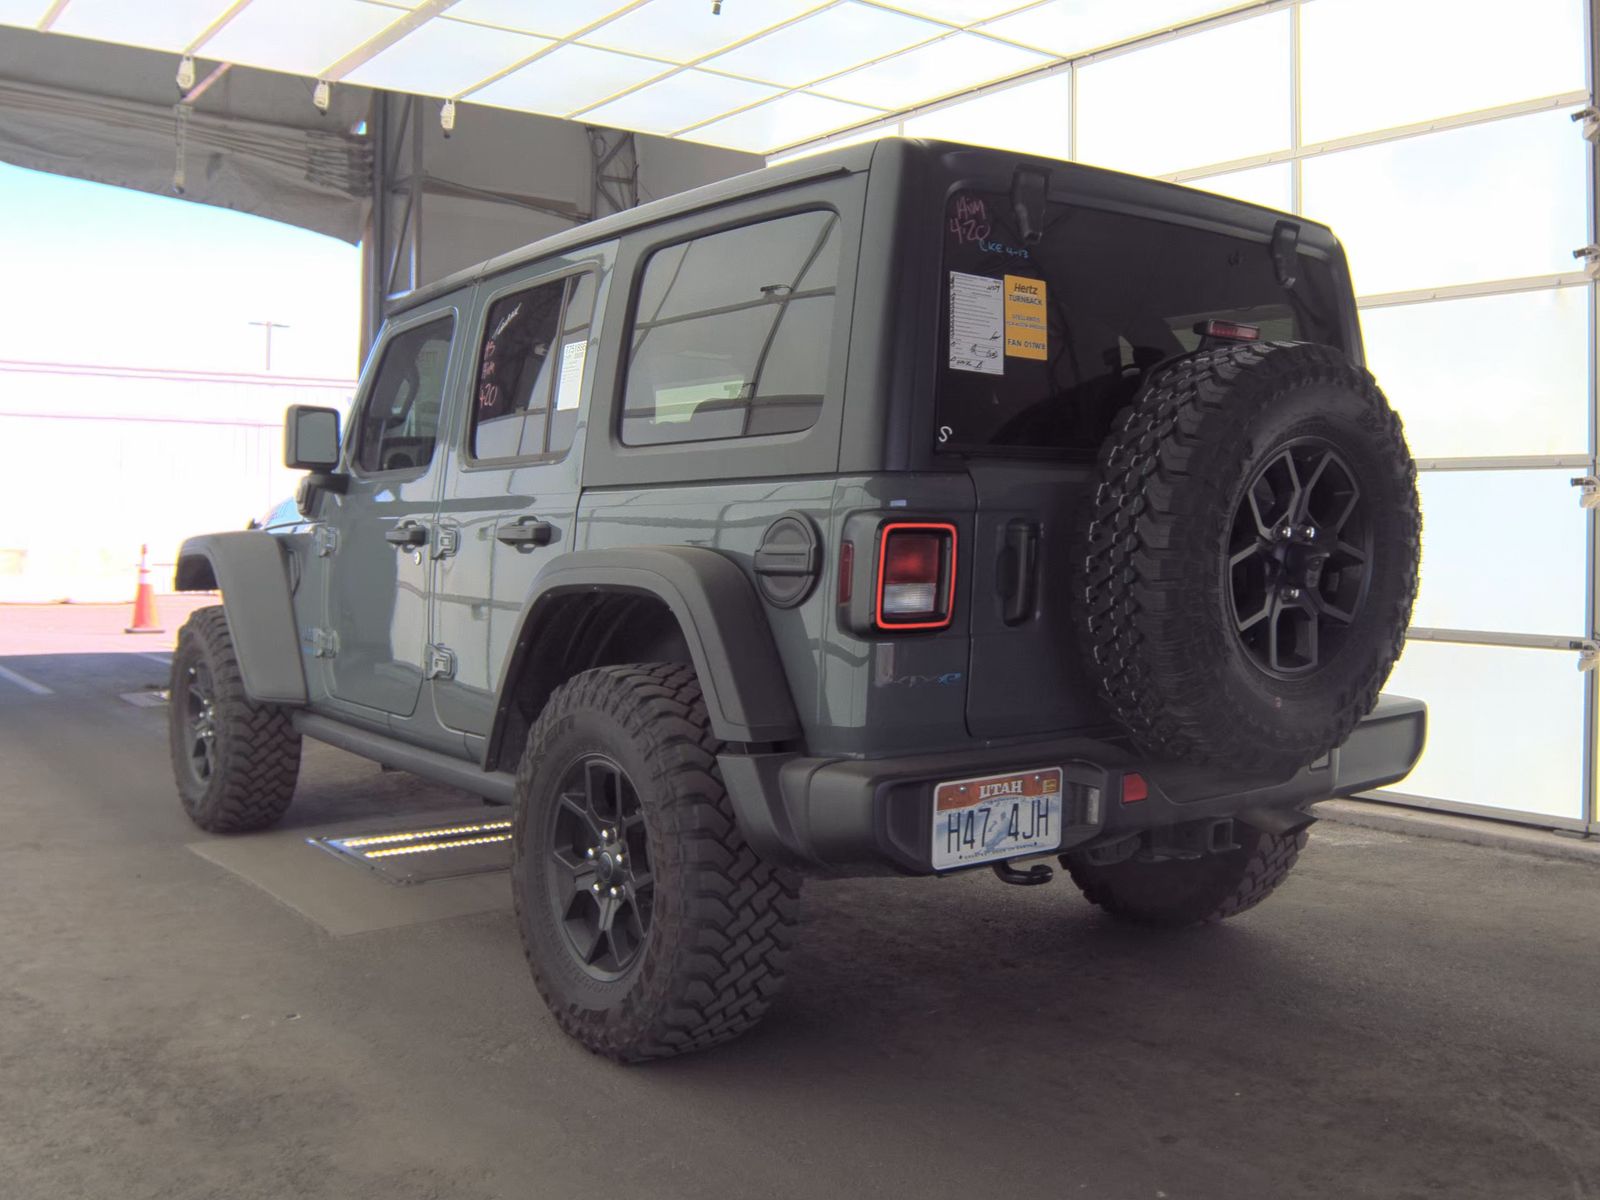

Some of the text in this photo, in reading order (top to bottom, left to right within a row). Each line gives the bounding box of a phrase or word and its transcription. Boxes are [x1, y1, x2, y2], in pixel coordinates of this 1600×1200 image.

[1014, 282, 1039, 295] Hertz
[1008, 294, 1043, 306] TURNBACK
[1007, 338, 1022, 348] FAN
[938, 426, 953, 443] S
[978, 779, 1024, 800] UTAH
[947, 807, 992, 854] H47
[1008, 798, 1049, 842] 4JH
